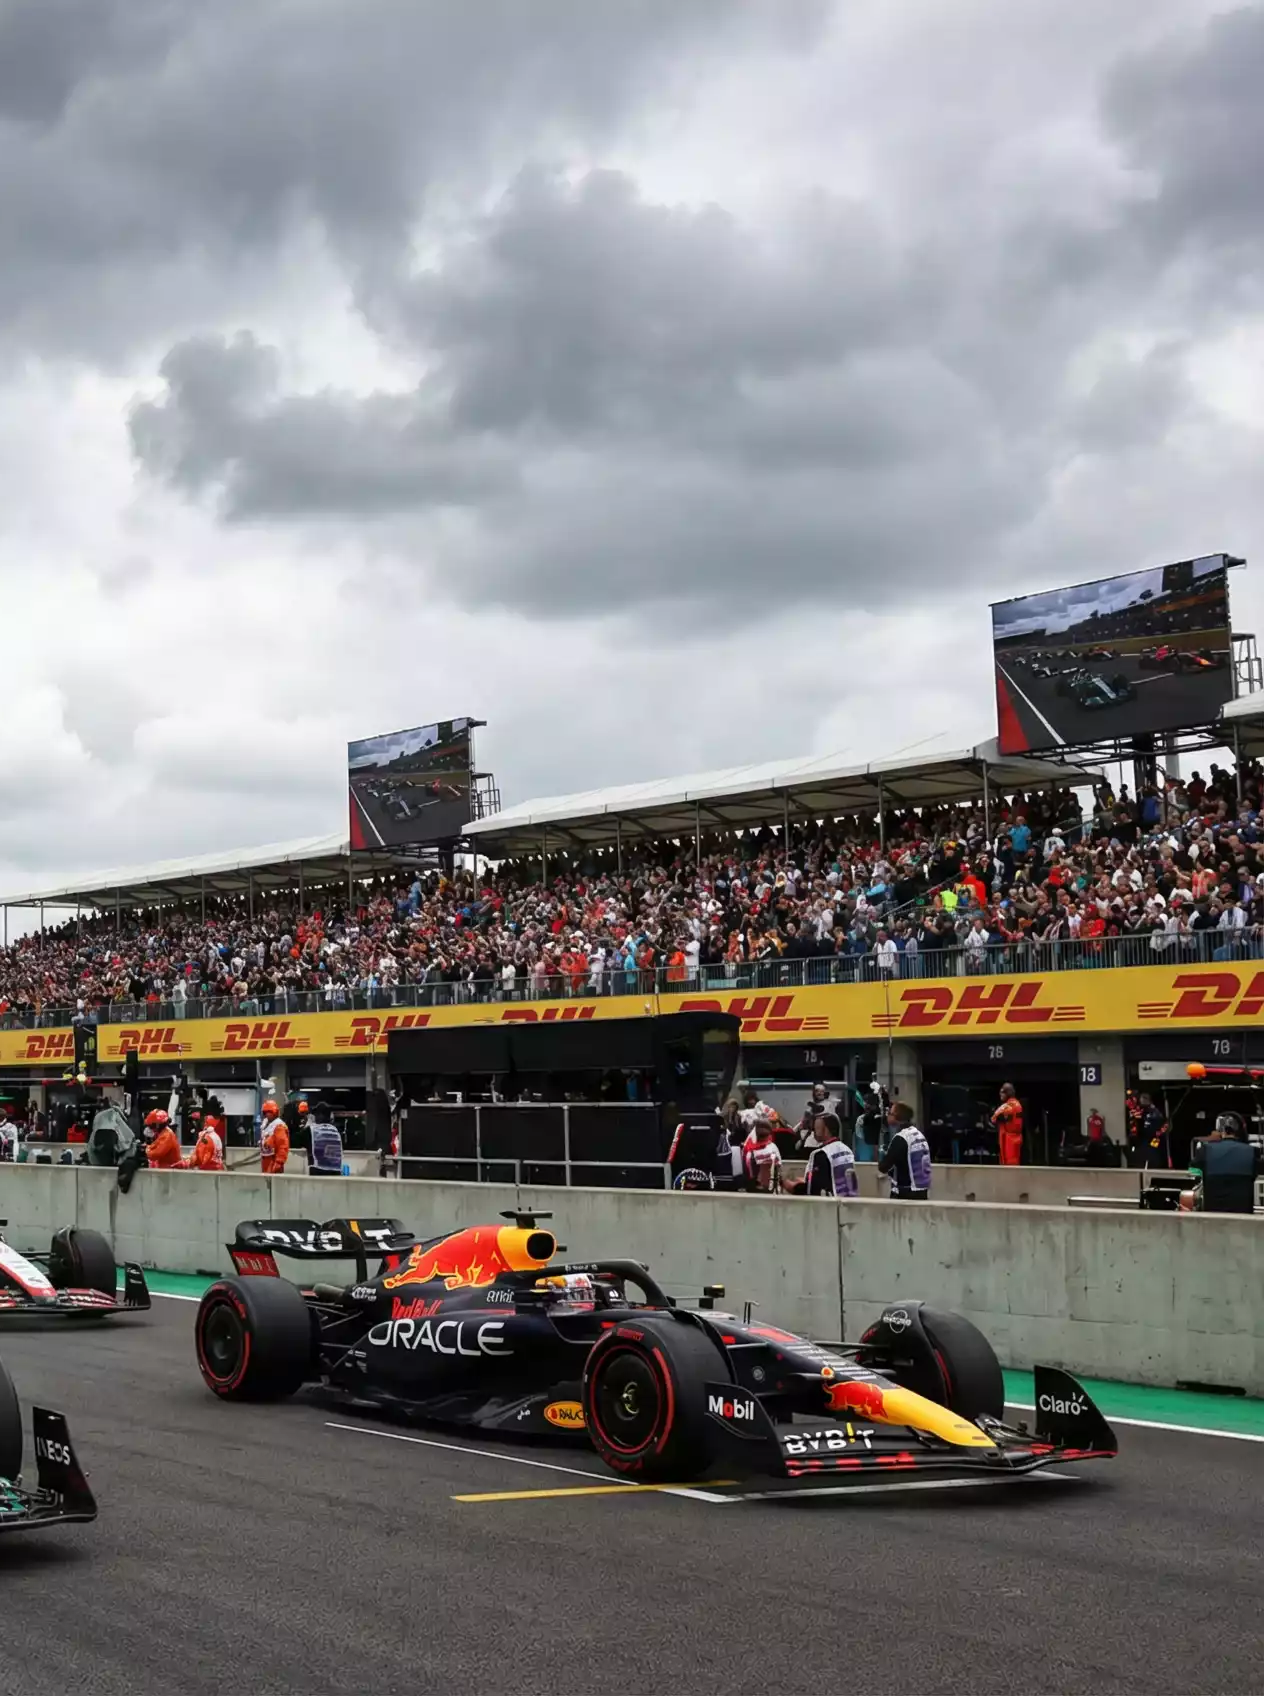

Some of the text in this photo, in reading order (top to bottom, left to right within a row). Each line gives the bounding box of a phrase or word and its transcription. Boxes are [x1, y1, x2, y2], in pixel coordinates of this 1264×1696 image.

[898, 981, 1055, 1027] DHL
[118, 1027, 186, 1055] DHL
[223, 1021, 296, 1050] DHL
[368, 1319, 515, 1356] ORACLE
[559, 1407, 584, 1421] RAUC
[708, 1395, 755, 1421] Mobil
[1039, 1393, 1082, 1415] Claro
